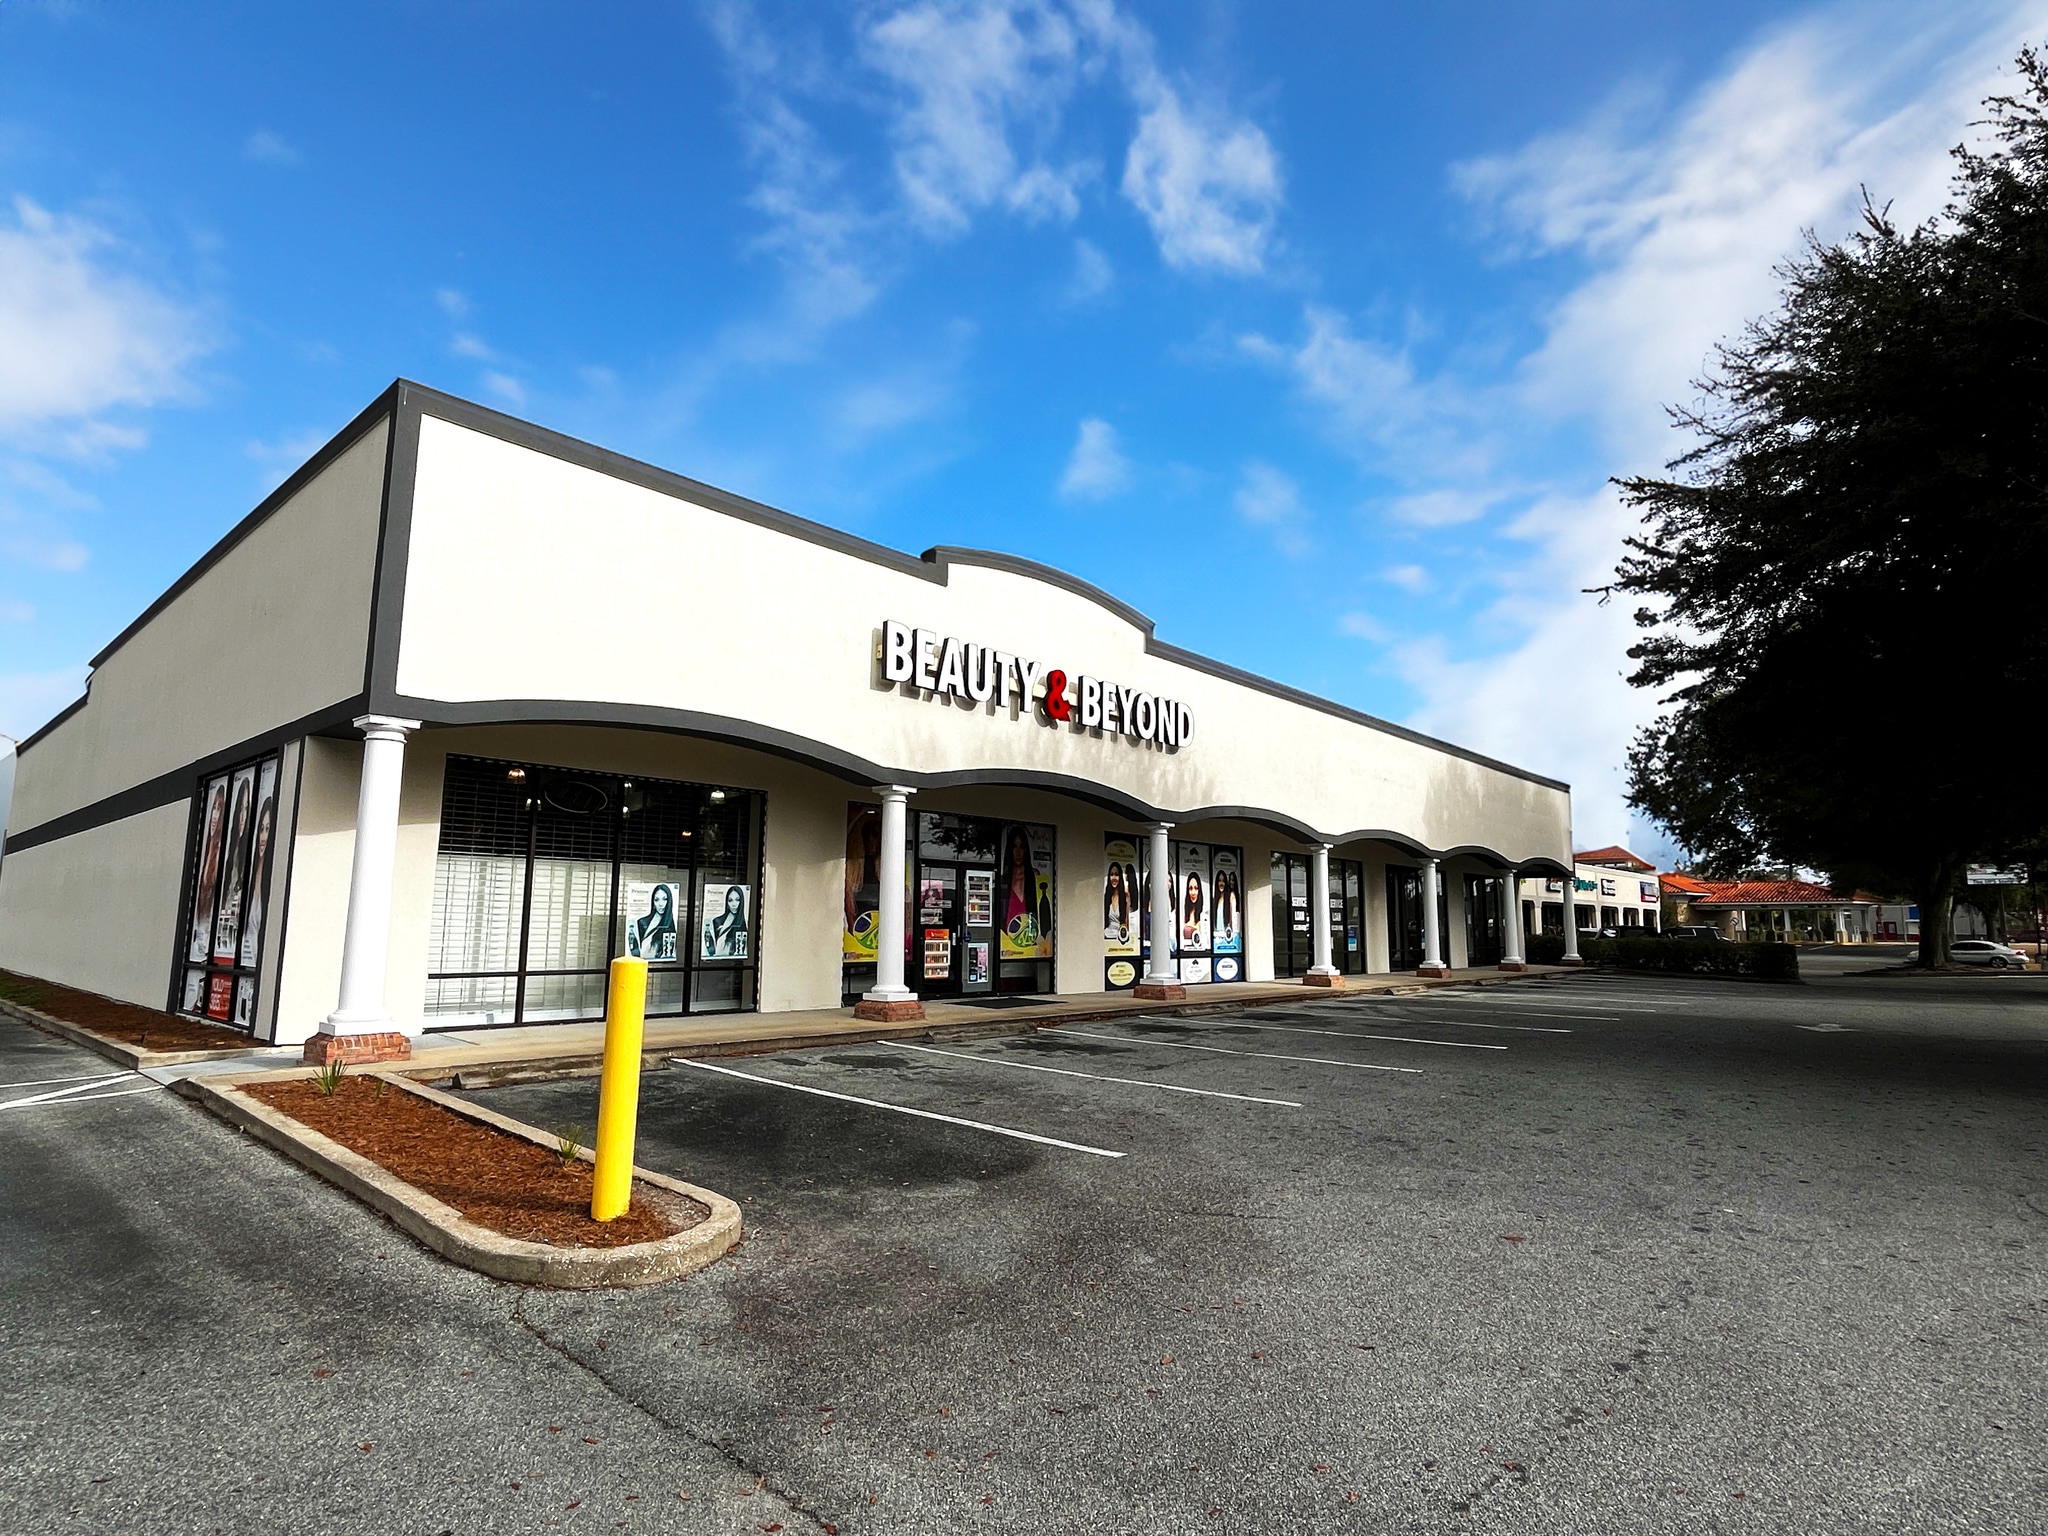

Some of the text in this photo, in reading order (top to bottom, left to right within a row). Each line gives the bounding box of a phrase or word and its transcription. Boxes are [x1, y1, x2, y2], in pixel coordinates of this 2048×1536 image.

[882, 619, 1195, 748] BEAUTY & BEYOND
